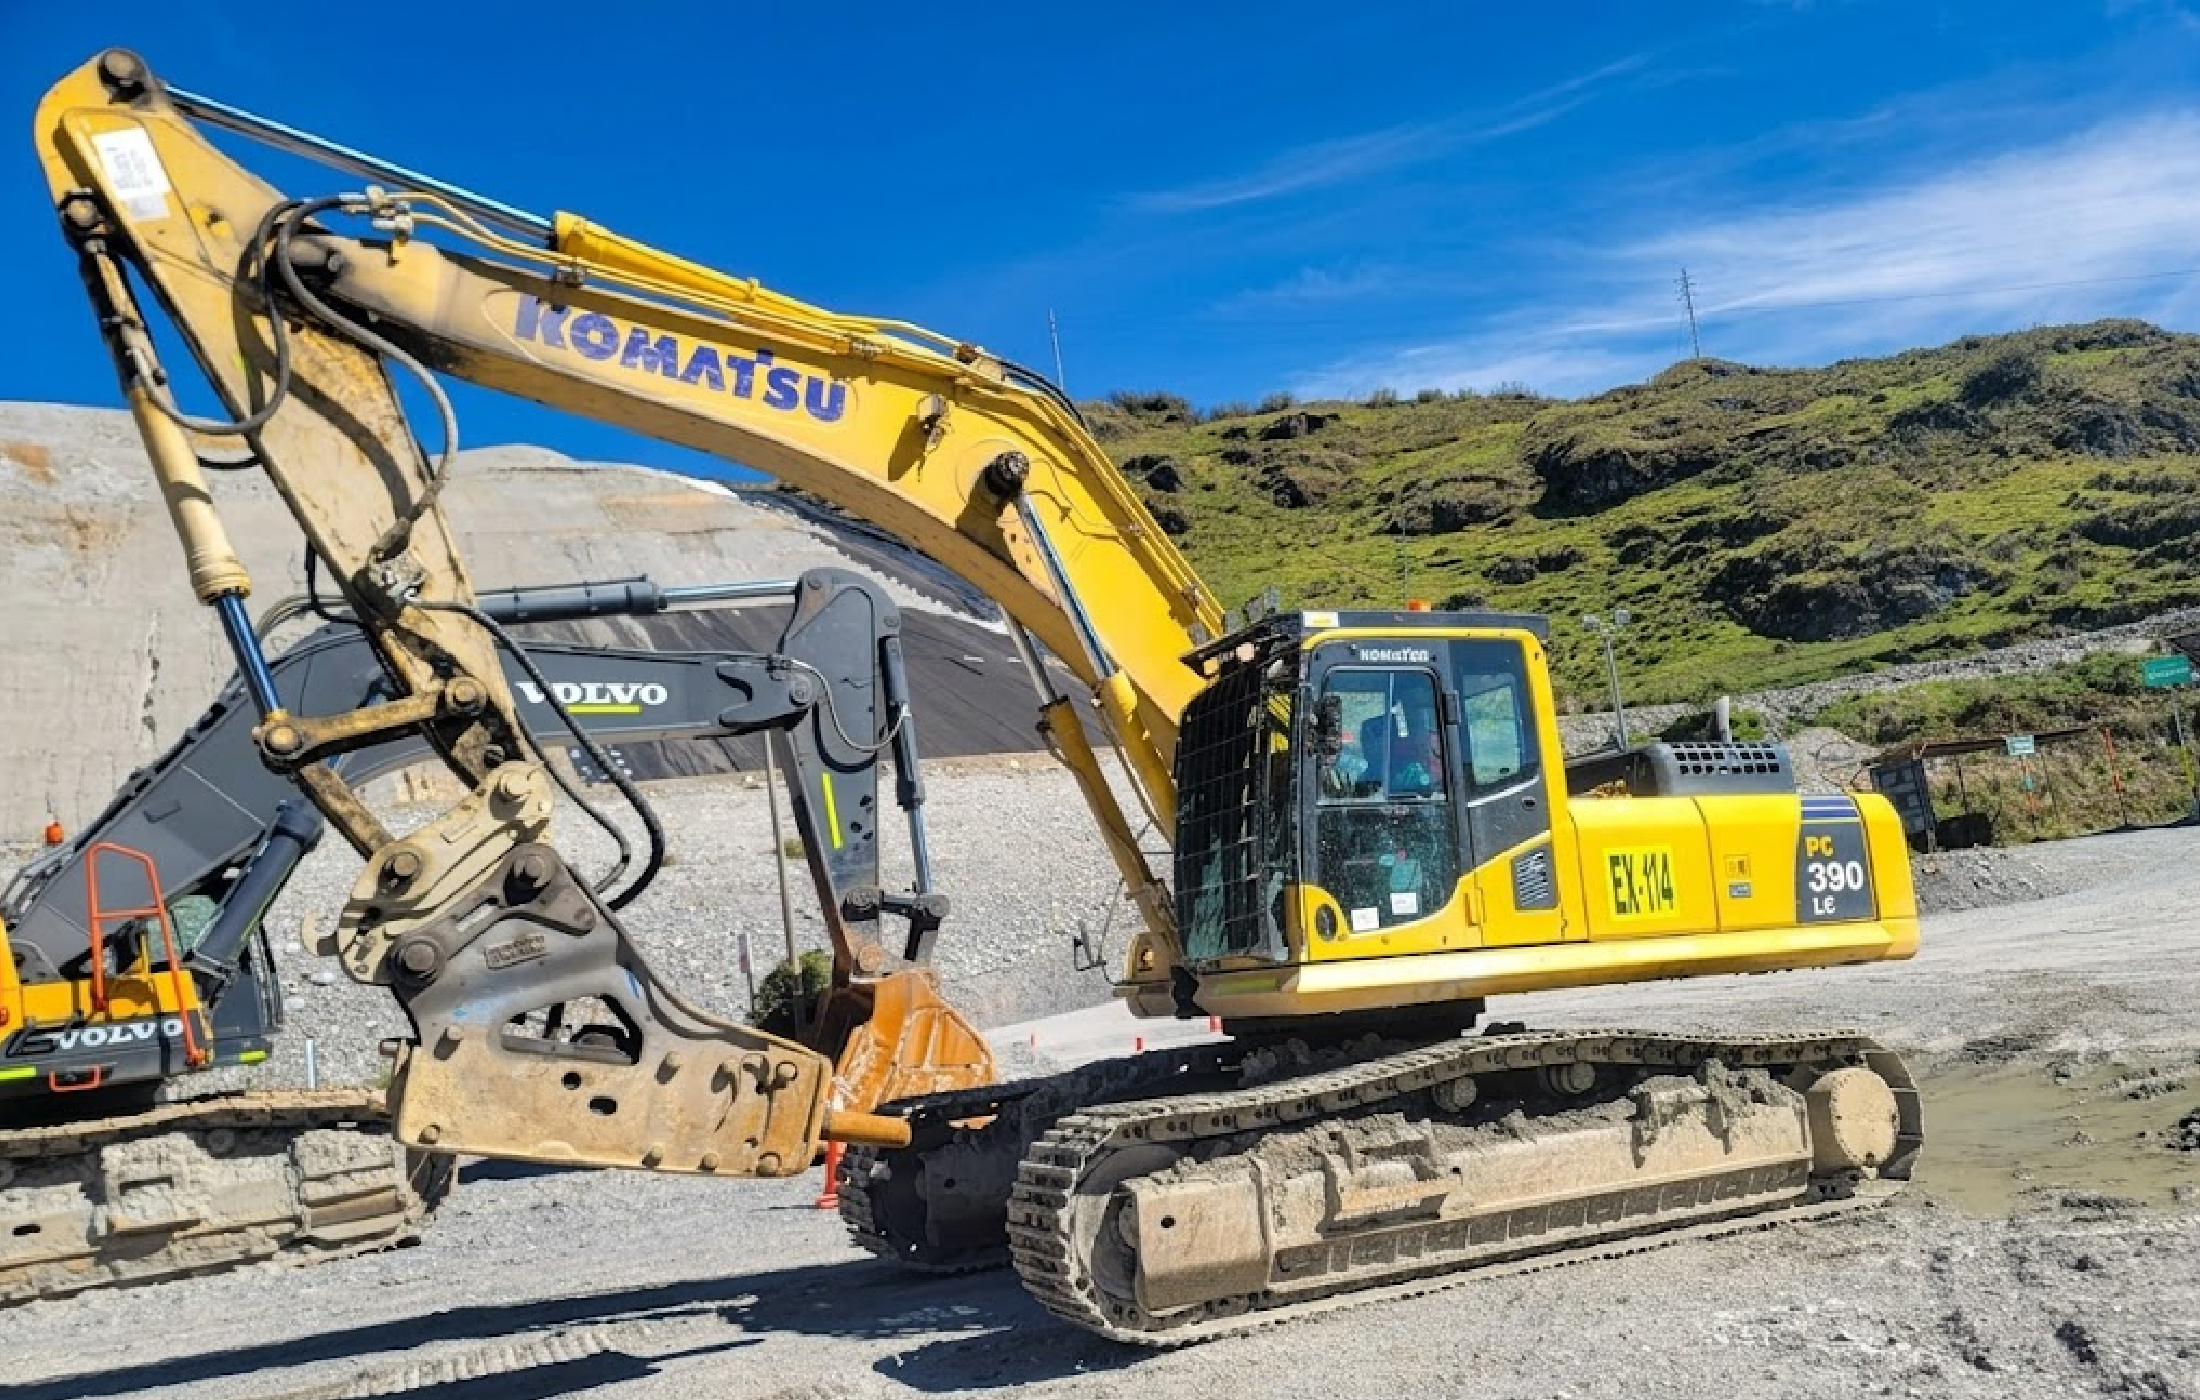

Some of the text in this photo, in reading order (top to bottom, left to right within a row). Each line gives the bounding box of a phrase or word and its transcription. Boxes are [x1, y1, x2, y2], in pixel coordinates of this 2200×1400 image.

[514, 294, 846, 423] KOMATSU
[514, 682, 668, 706] VOLVO
[1804, 835, 1833, 857] PC
[1808, 860, 1864, 893] 390
[45, 1018, 184, 1050] VOLVO
